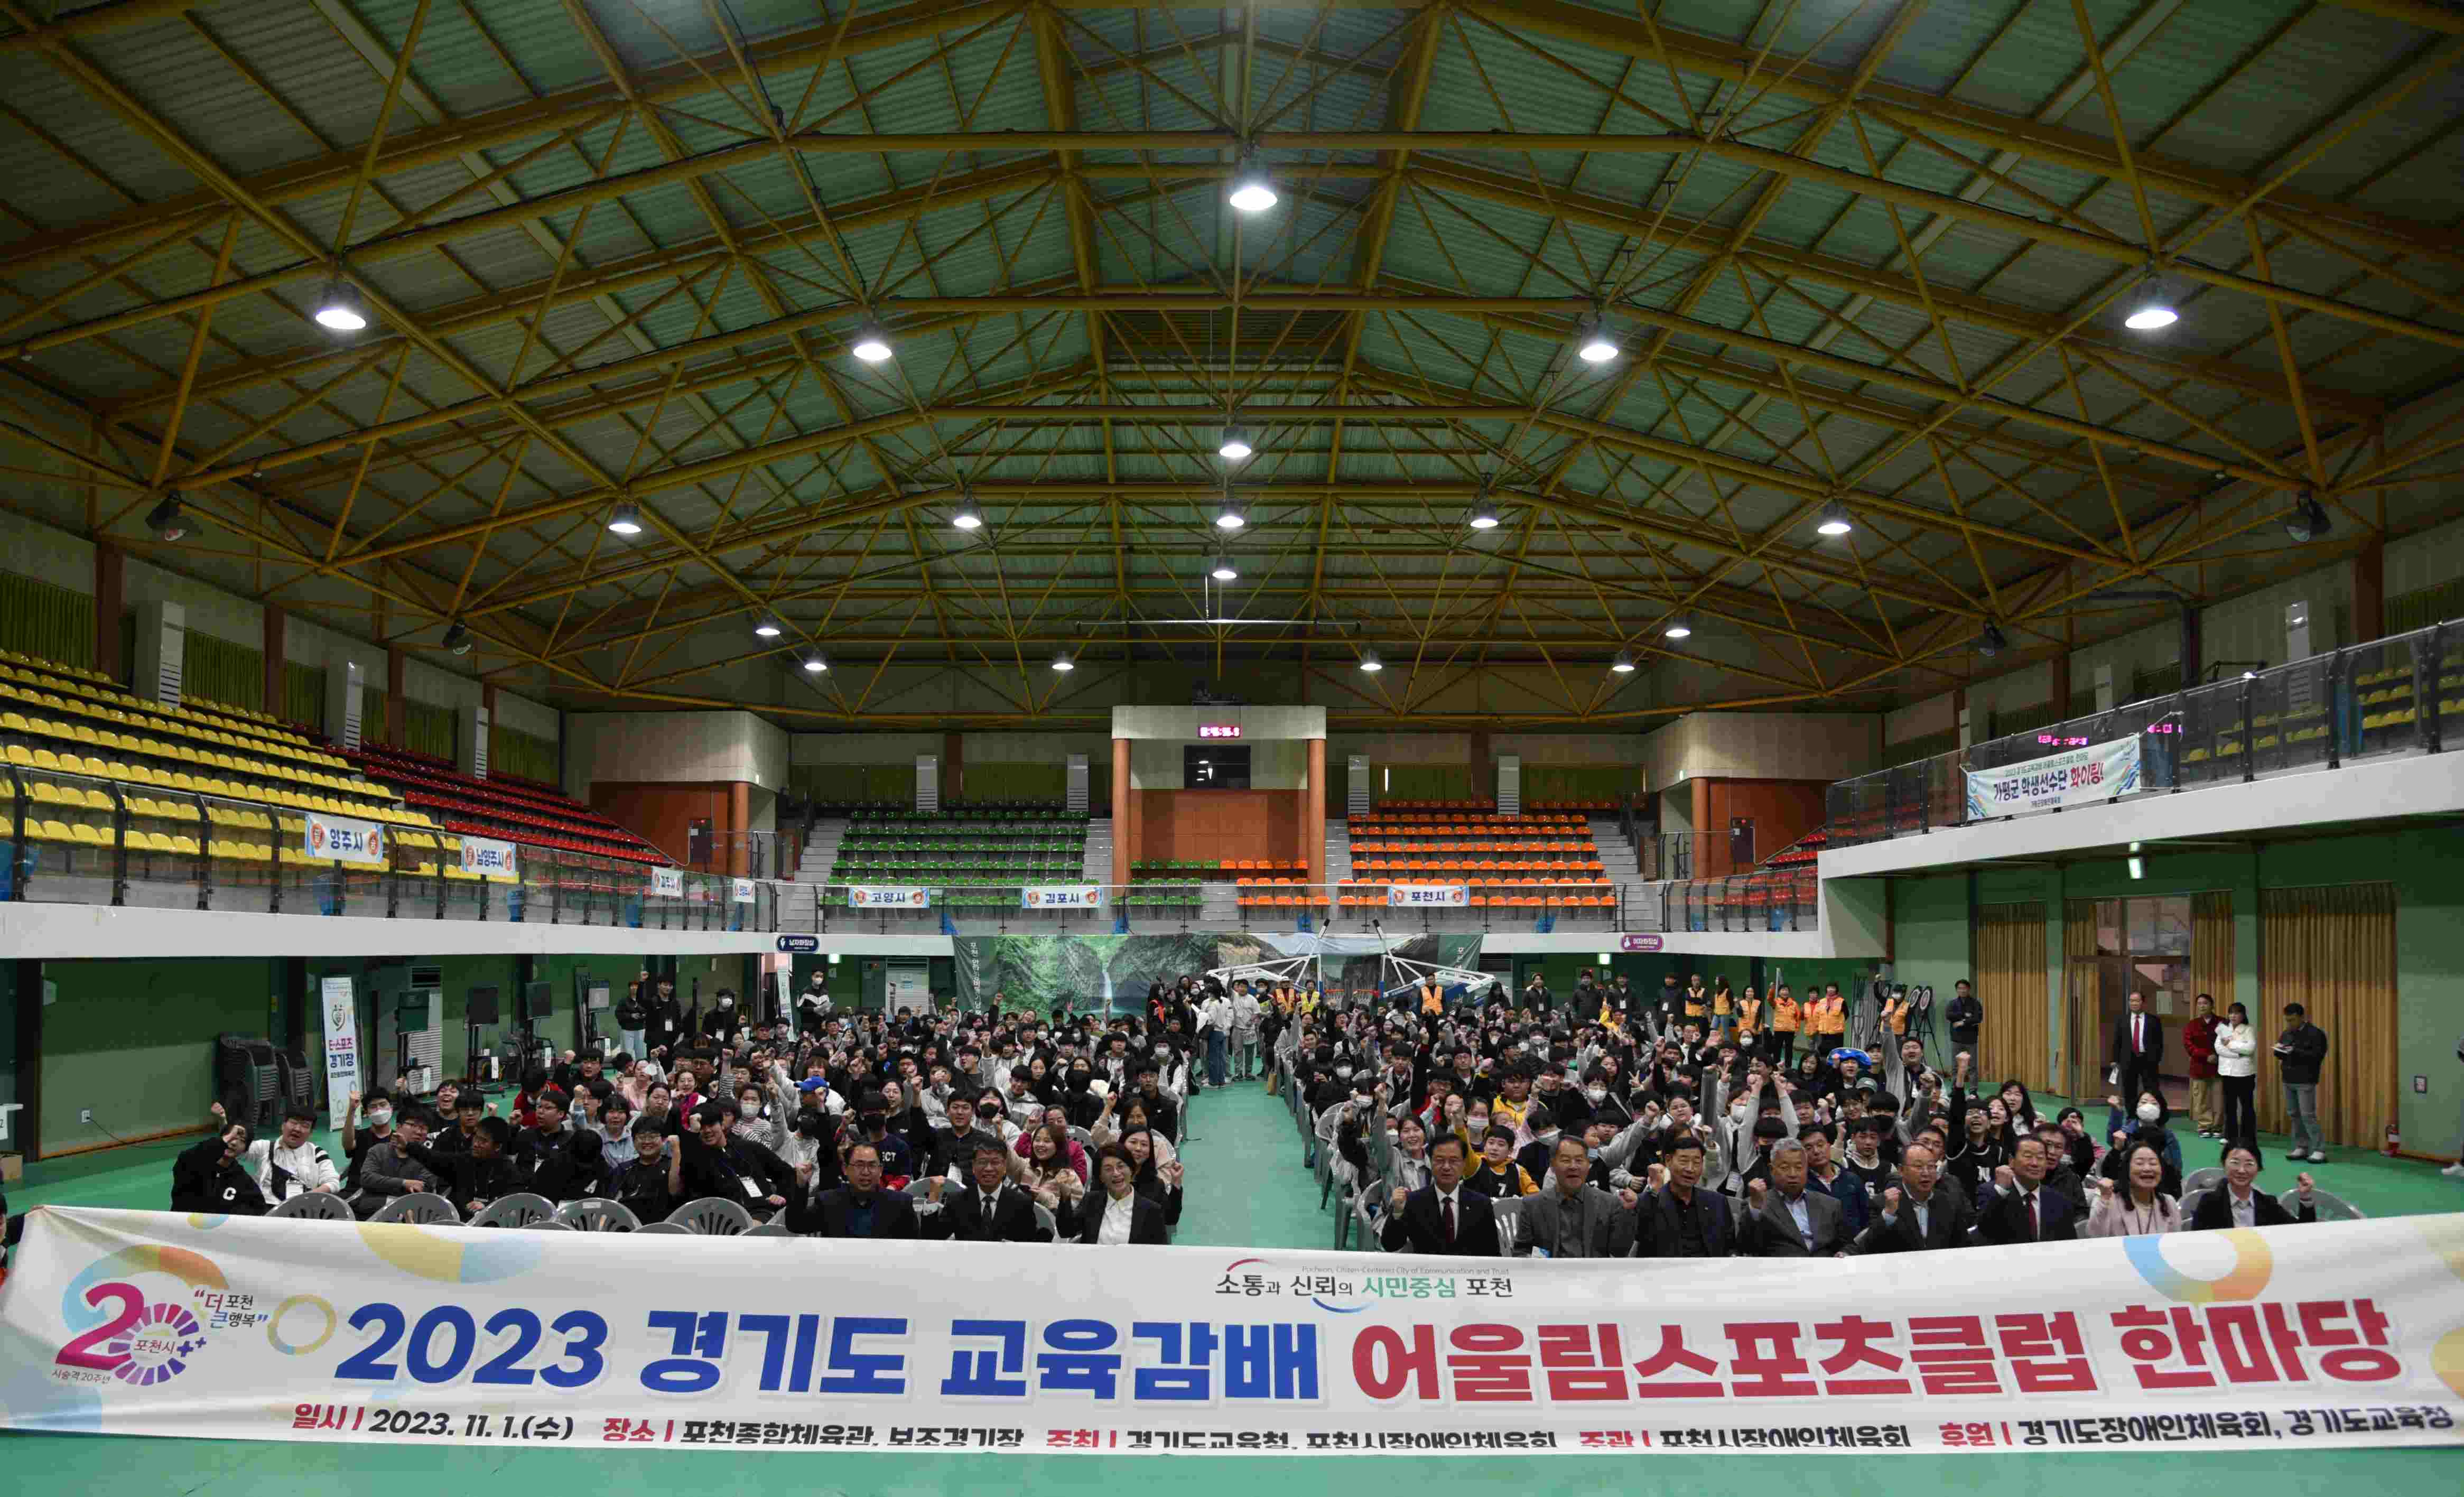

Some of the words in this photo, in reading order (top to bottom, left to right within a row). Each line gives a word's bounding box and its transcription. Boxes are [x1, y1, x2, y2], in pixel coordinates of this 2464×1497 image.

[1994, 772, 2019, 802] 가평군
[2021, 769, 2068, 796] 학생선수단
[2070, 761, 2105, 789] 화이팅!
[330, 828, 363, 852] 양주시
[477, 848, 504, 868] 남양주시
[872, 892, 905, 903] 고양시
[1045, 892, 1080, 904] 김포시
[1411, 891, 1446, 902] 포천시
[329, 1053, 354, 1068] 경기장
[223, 1187, 237, 1201] C
[1215, 1274, 1281, 1297] 소통과
[1289, 1275, 1353, 1297] 신뢰의
[1361, 1276, 1456, 1298] 시민중심
[1466, 1277, 1513, 1298] 포천
[225, 1295, 254, 1310] 포천
[334, 1303, 609, 1388] 2023
[640, 1309, 908, 1395] 경기도
[941, 1318, 1319, 1401] 교육감배
[1352, 1310, 2098, 1402] 어울림스포츠클럽
[2109, 1298, 2402, 1389] 한마당
[292, 1403, 346, 1430] 일시
[368, 1408, 454, 1436] 2023.
[466, 1415, 492, 1437] 11.
[602, 1417, 655, 1442] 장소
[1579, 1430, 1633, 1448] 주관
[1939, 1422, 1996, 1447] 후원
[2283, 1405, 2454, 1437] 경기도교육청
